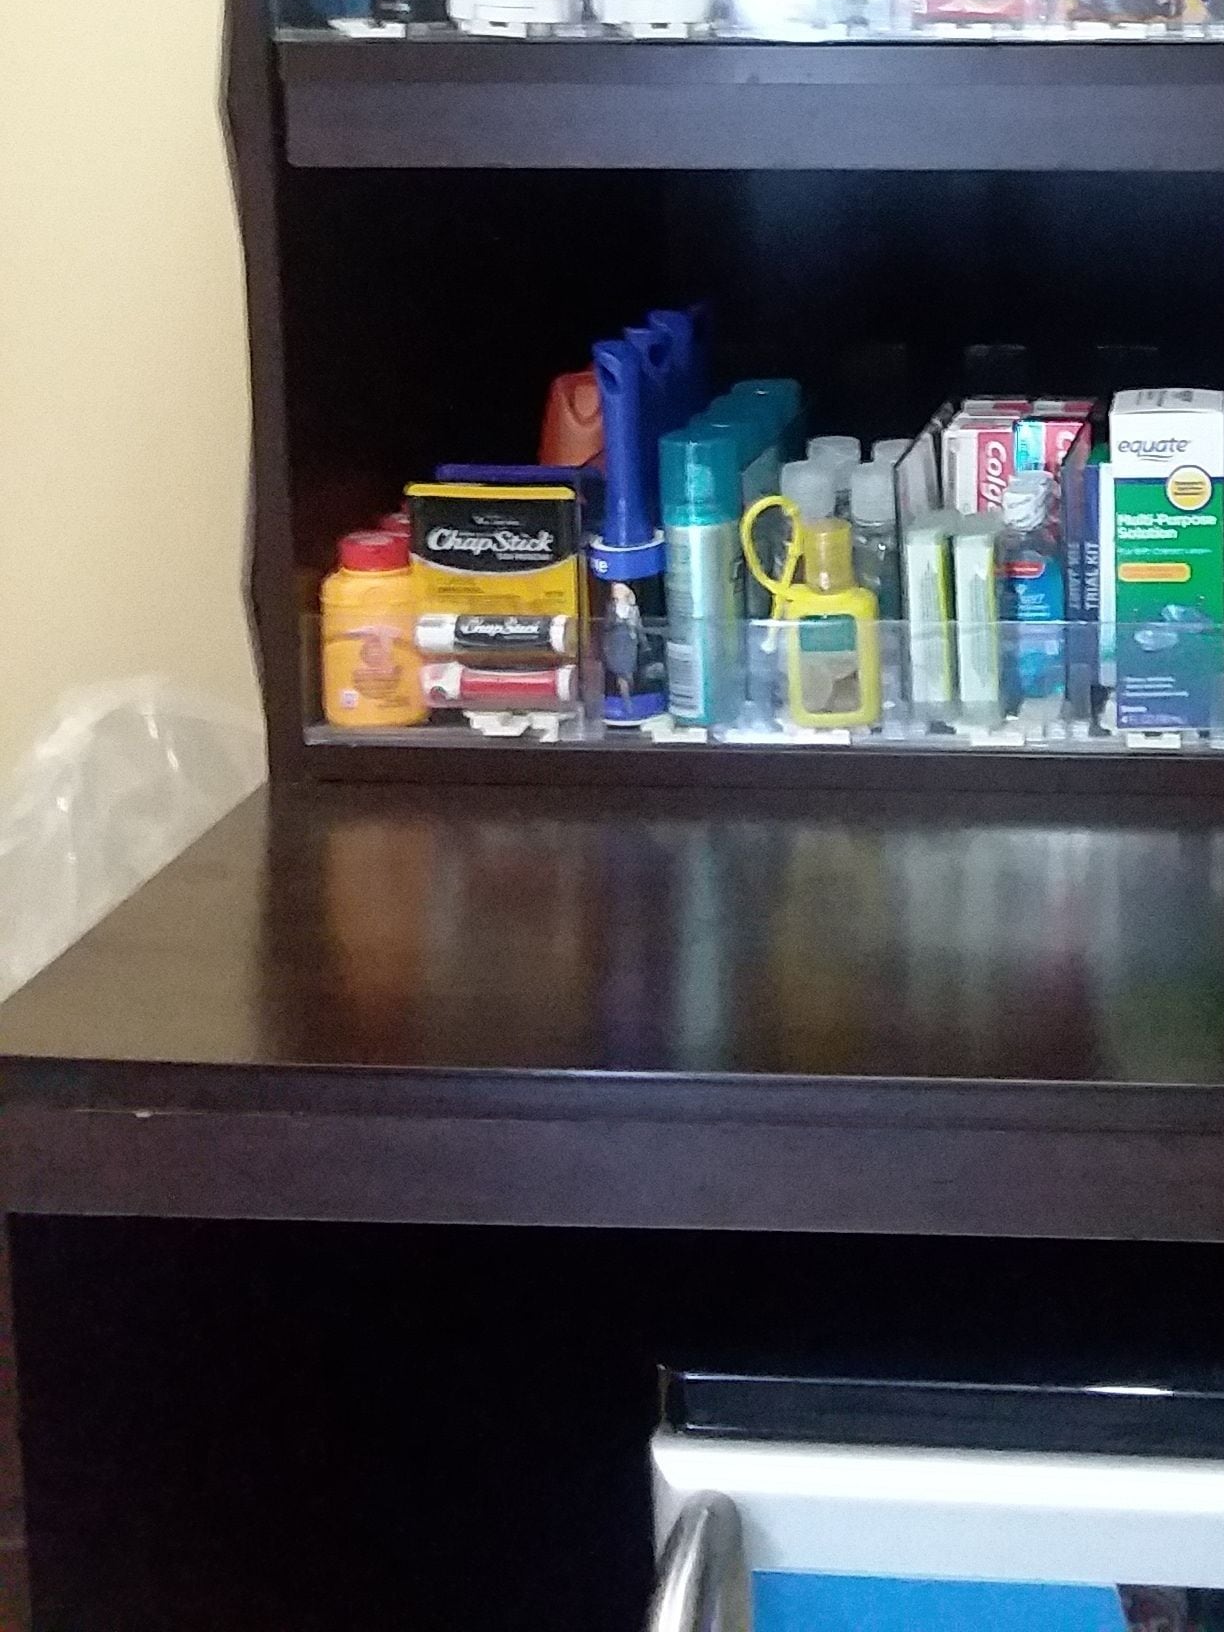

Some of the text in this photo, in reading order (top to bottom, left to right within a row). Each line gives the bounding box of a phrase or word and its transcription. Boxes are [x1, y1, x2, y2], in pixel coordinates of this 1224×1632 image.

[1118, 438, 1190, 454] equate
[980, 440, 1008, 513] Colg
[1117, 514, 1217, 527] Multi-Purpose
[427, 527, 554, 556] ChapStick
[1118, 527, 1178, 539] Solution
[1084, 541, 1100, 610] TRIAL KIT
